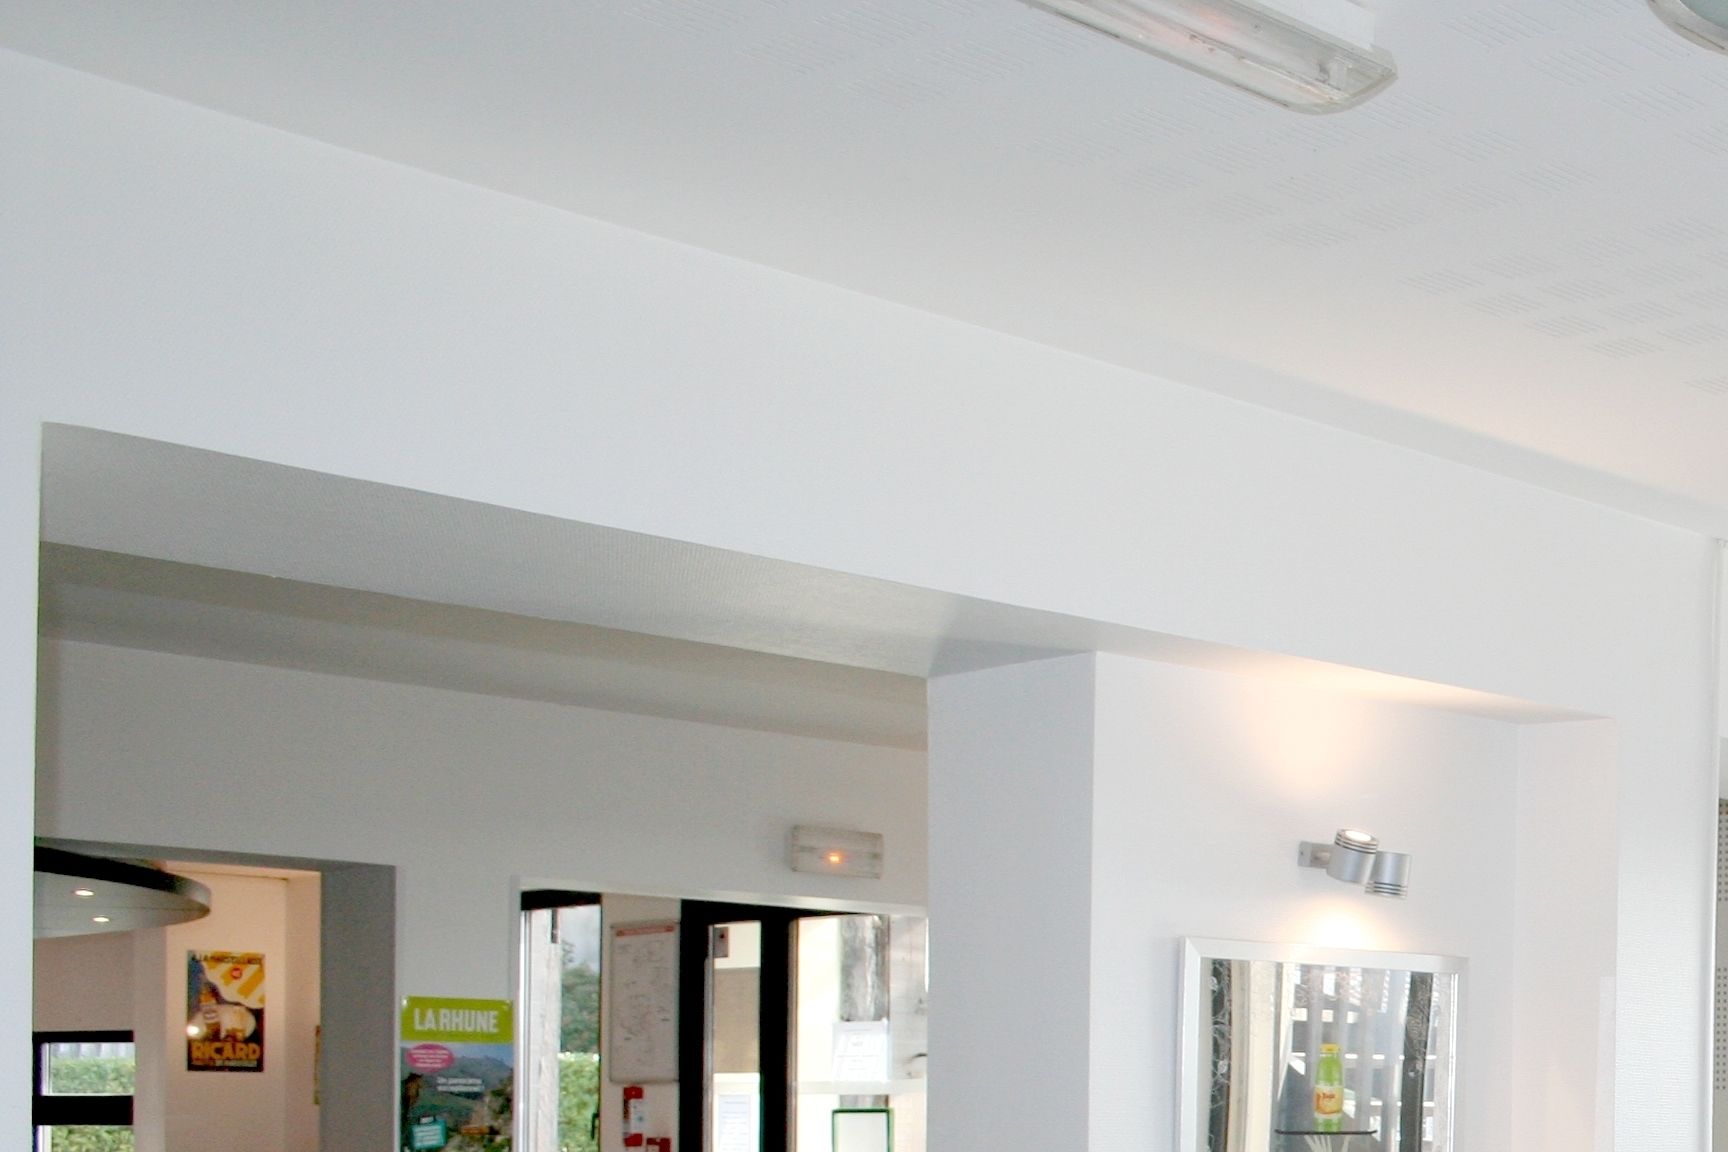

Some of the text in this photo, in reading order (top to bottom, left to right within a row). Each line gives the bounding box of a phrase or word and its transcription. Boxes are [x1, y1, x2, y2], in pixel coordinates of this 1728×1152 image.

[414, 1008, 498, 1033] LA RHUNE
[191, 1041, 260, 1062] RICARD
